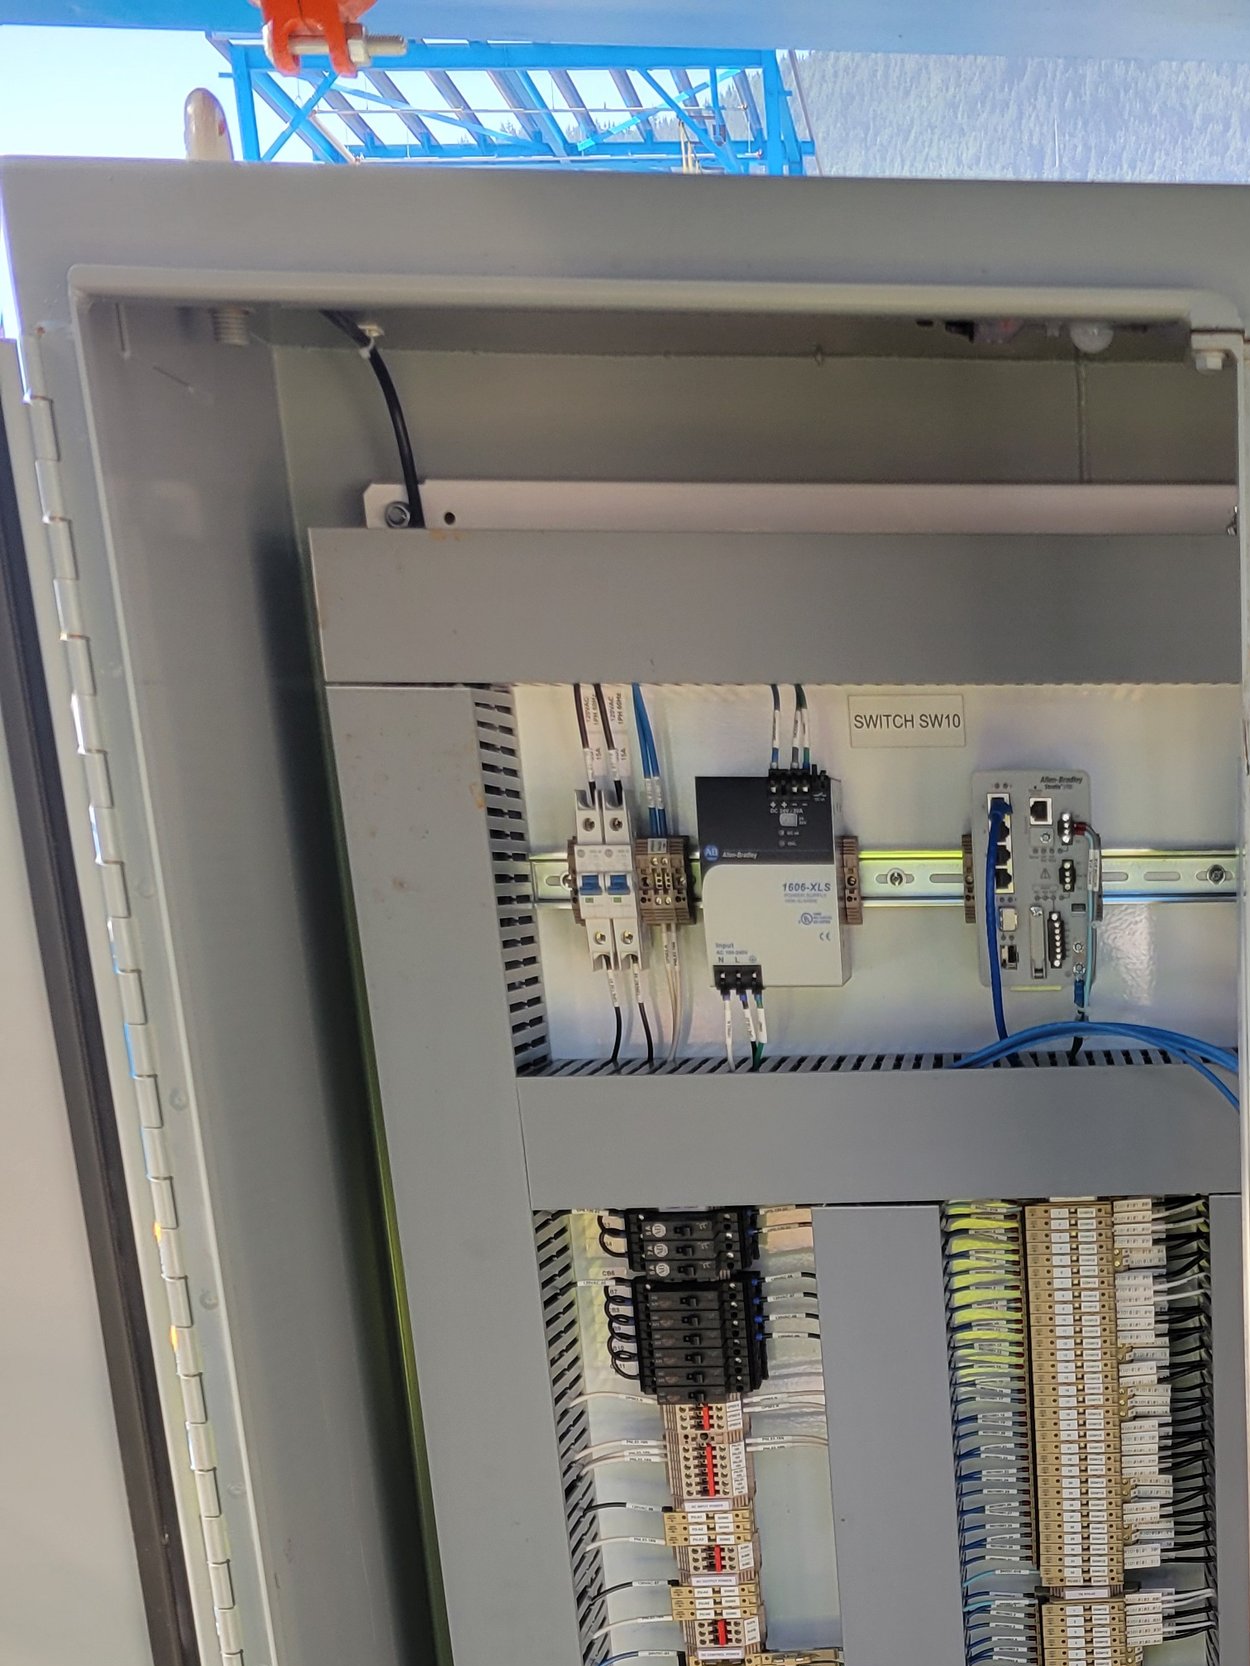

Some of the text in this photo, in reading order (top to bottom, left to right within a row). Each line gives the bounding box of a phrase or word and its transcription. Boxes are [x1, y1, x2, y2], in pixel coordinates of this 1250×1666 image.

[853, 714, 962, 730] SWITCH SW10
[1040, 776, 1083, 784] Allen-Bradley
[782, 882, 831, 893] 1606-XLS
